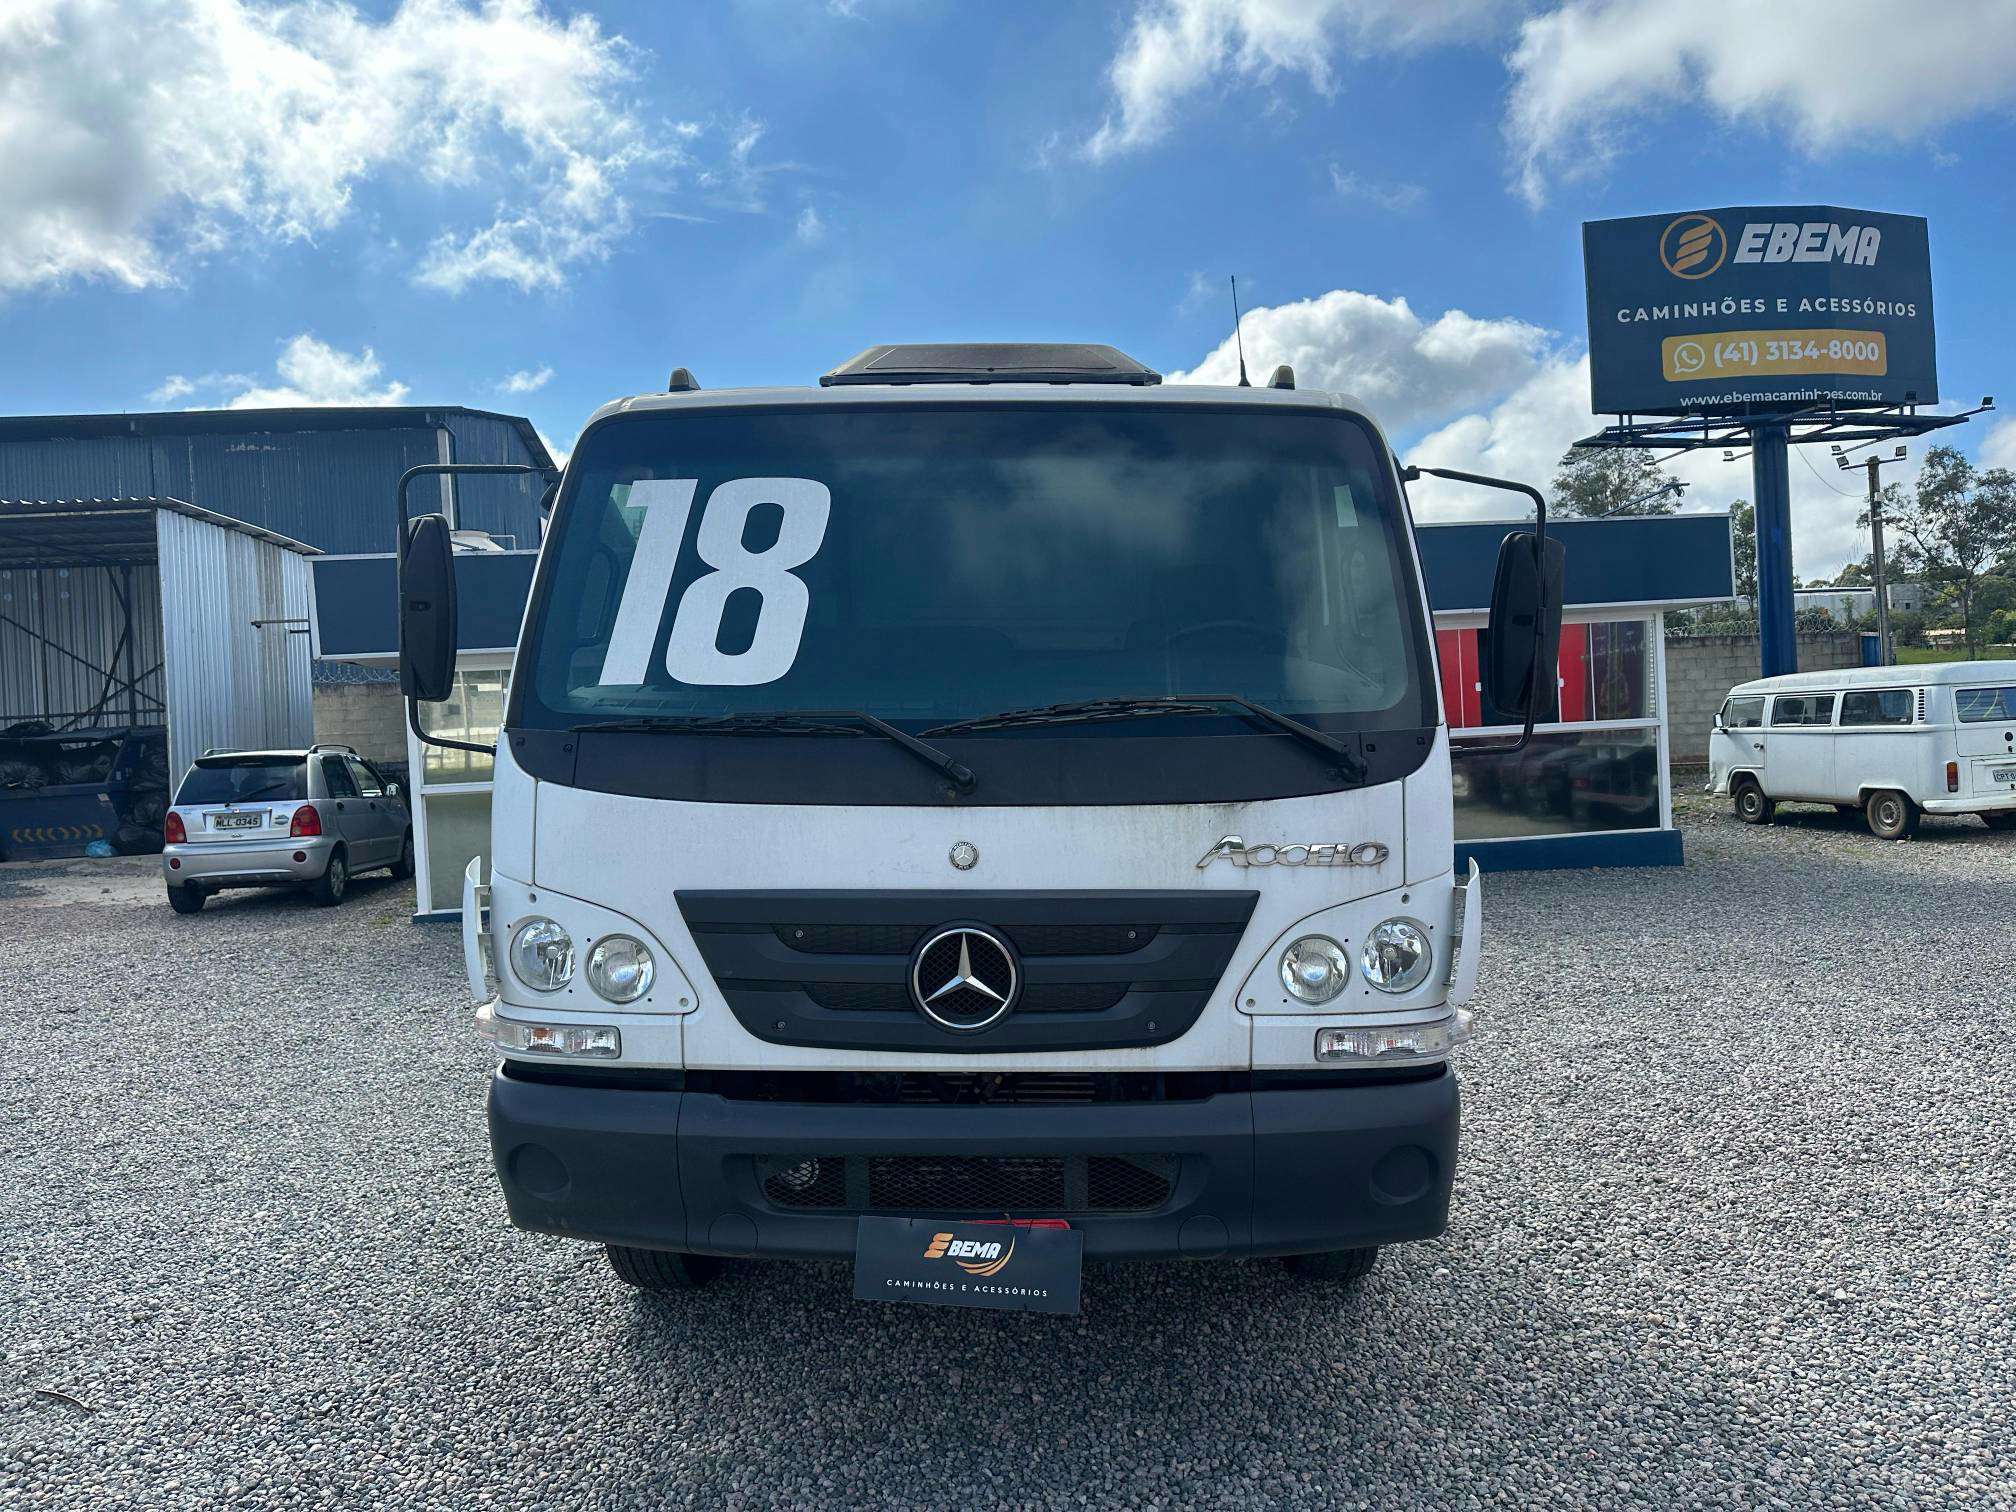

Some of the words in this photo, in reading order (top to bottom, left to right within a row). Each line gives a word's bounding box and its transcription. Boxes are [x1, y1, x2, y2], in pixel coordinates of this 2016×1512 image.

[1733, 222, 1882, 266] EBEMA
[1616, 296, 1766, 323] CAMINHÕES
[1776, 298, 1788, 313] E
[1798, 297, 1917, 317] ACESSÓRIOS
[1713, 342, 1758, 367] (41)
[1765, 339, 1880, 362] 3134-8000
[598, 476, 832, 687] 18
[923, 1232, 1002, 1260] EBEMA
[886, 1279, 955, 1291] CAMINHÕES
[961, 1284, 968, 1292] E
[974, 1285, 1048, 1297] ACESSÓRIOS
